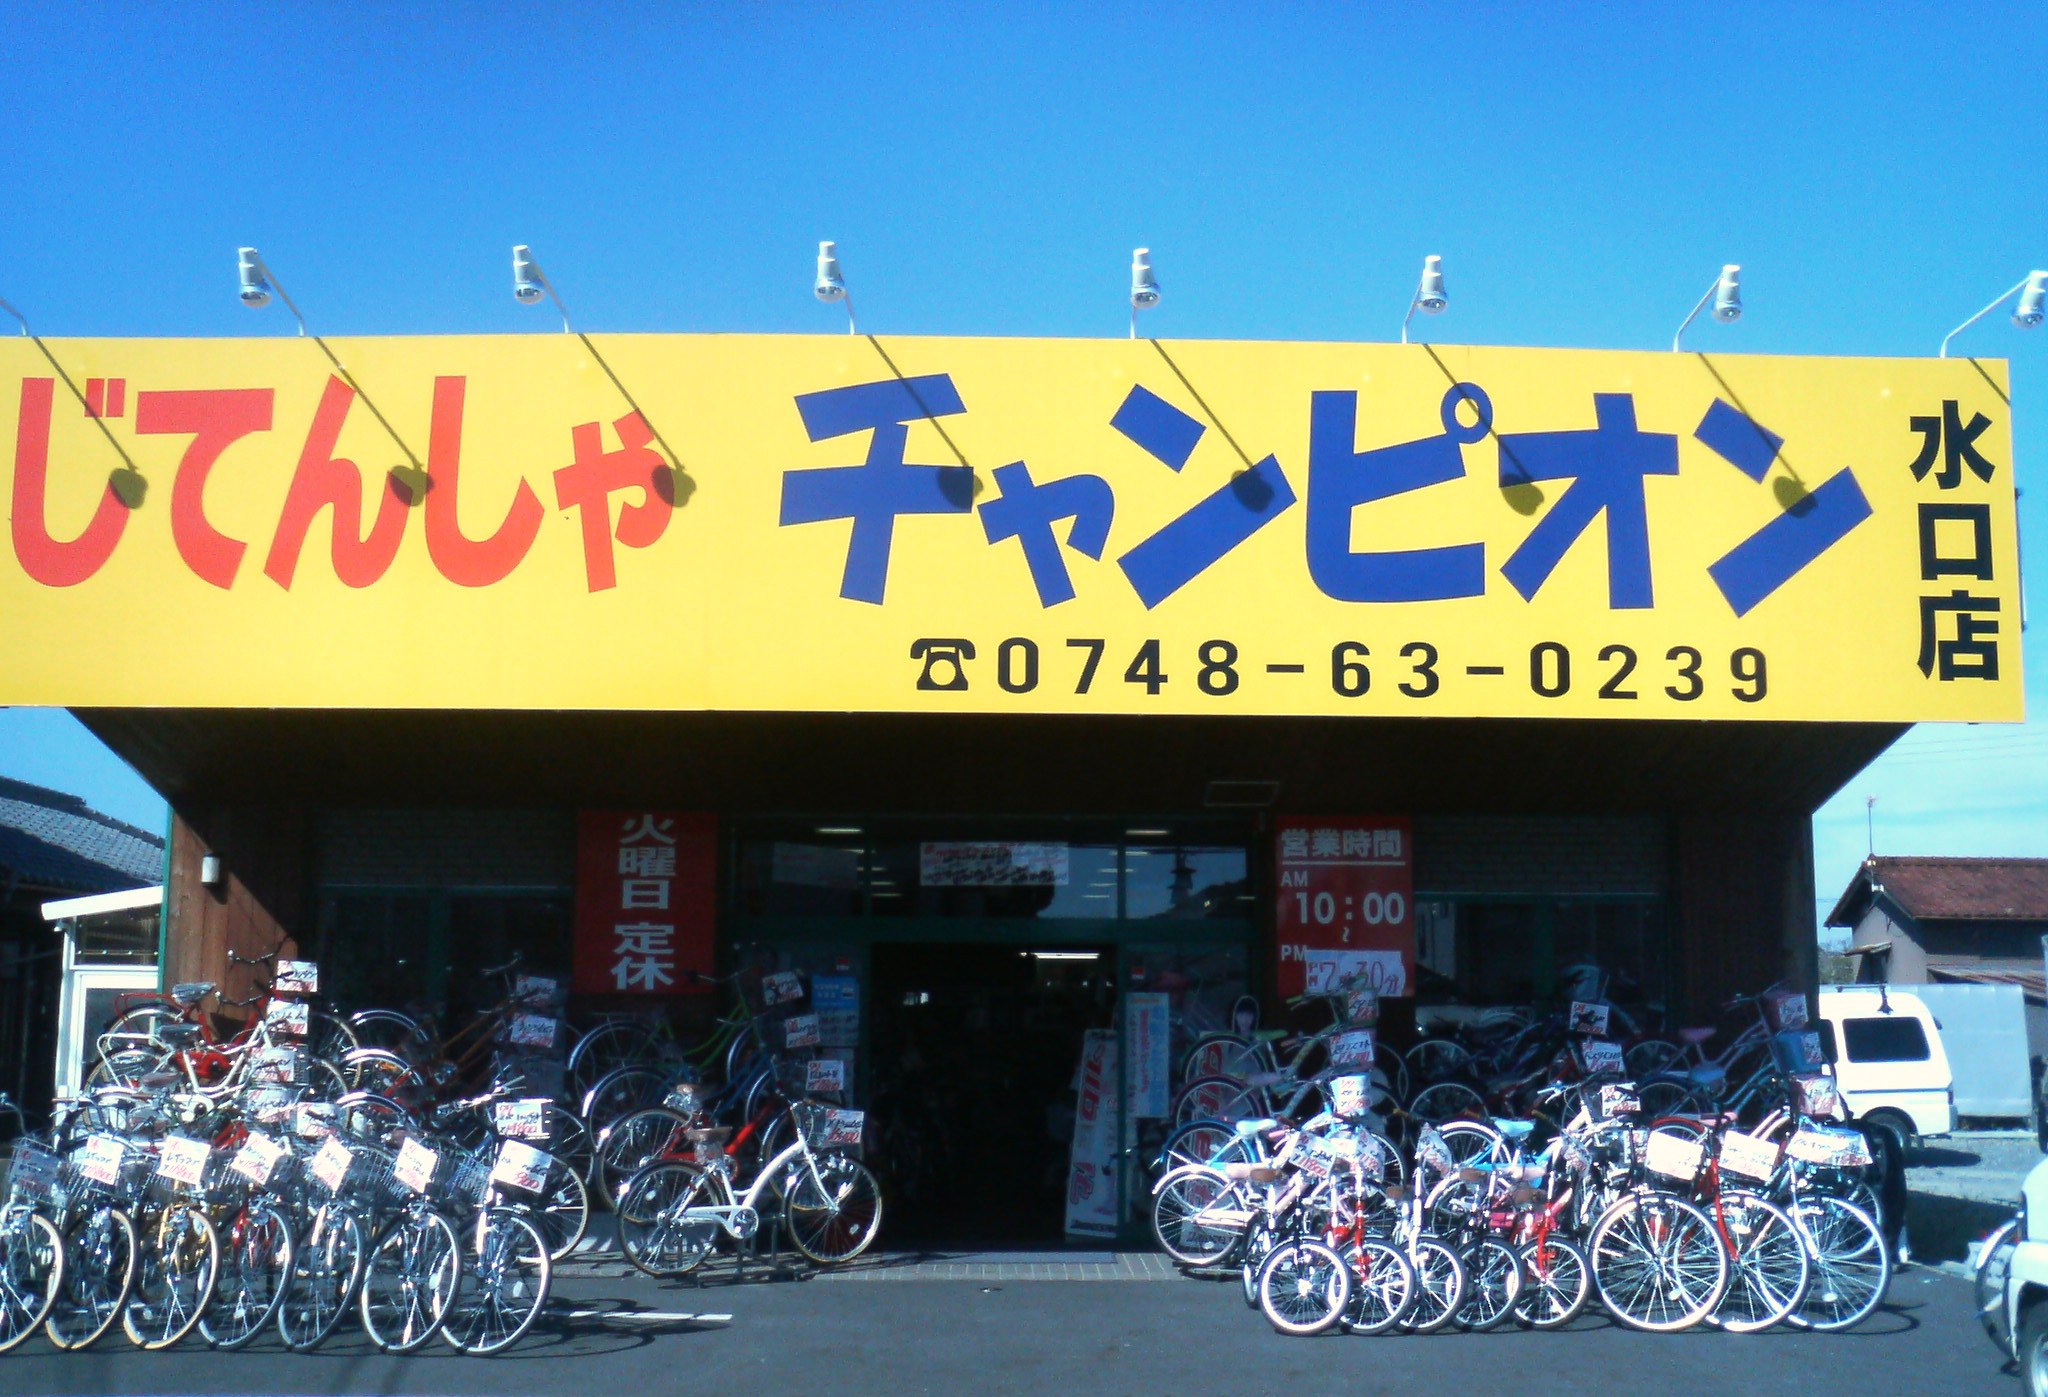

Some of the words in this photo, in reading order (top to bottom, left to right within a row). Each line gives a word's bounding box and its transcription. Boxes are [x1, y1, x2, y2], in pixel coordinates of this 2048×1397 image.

[11, 374, 675, 593] じてんしゃ
[780, 373, 1873, 618] チャンピオン
[1909, 400, 2001, 682] 水口店
[997, 637, 1767, 703] 0748-63-0239
[1281, 829, 1402, 858] 営業時間
[1280, 870, 1309, 887] AM
[1296, 891, 1405, 925] 10:00
[1280, 944, 1308, 962] PM
